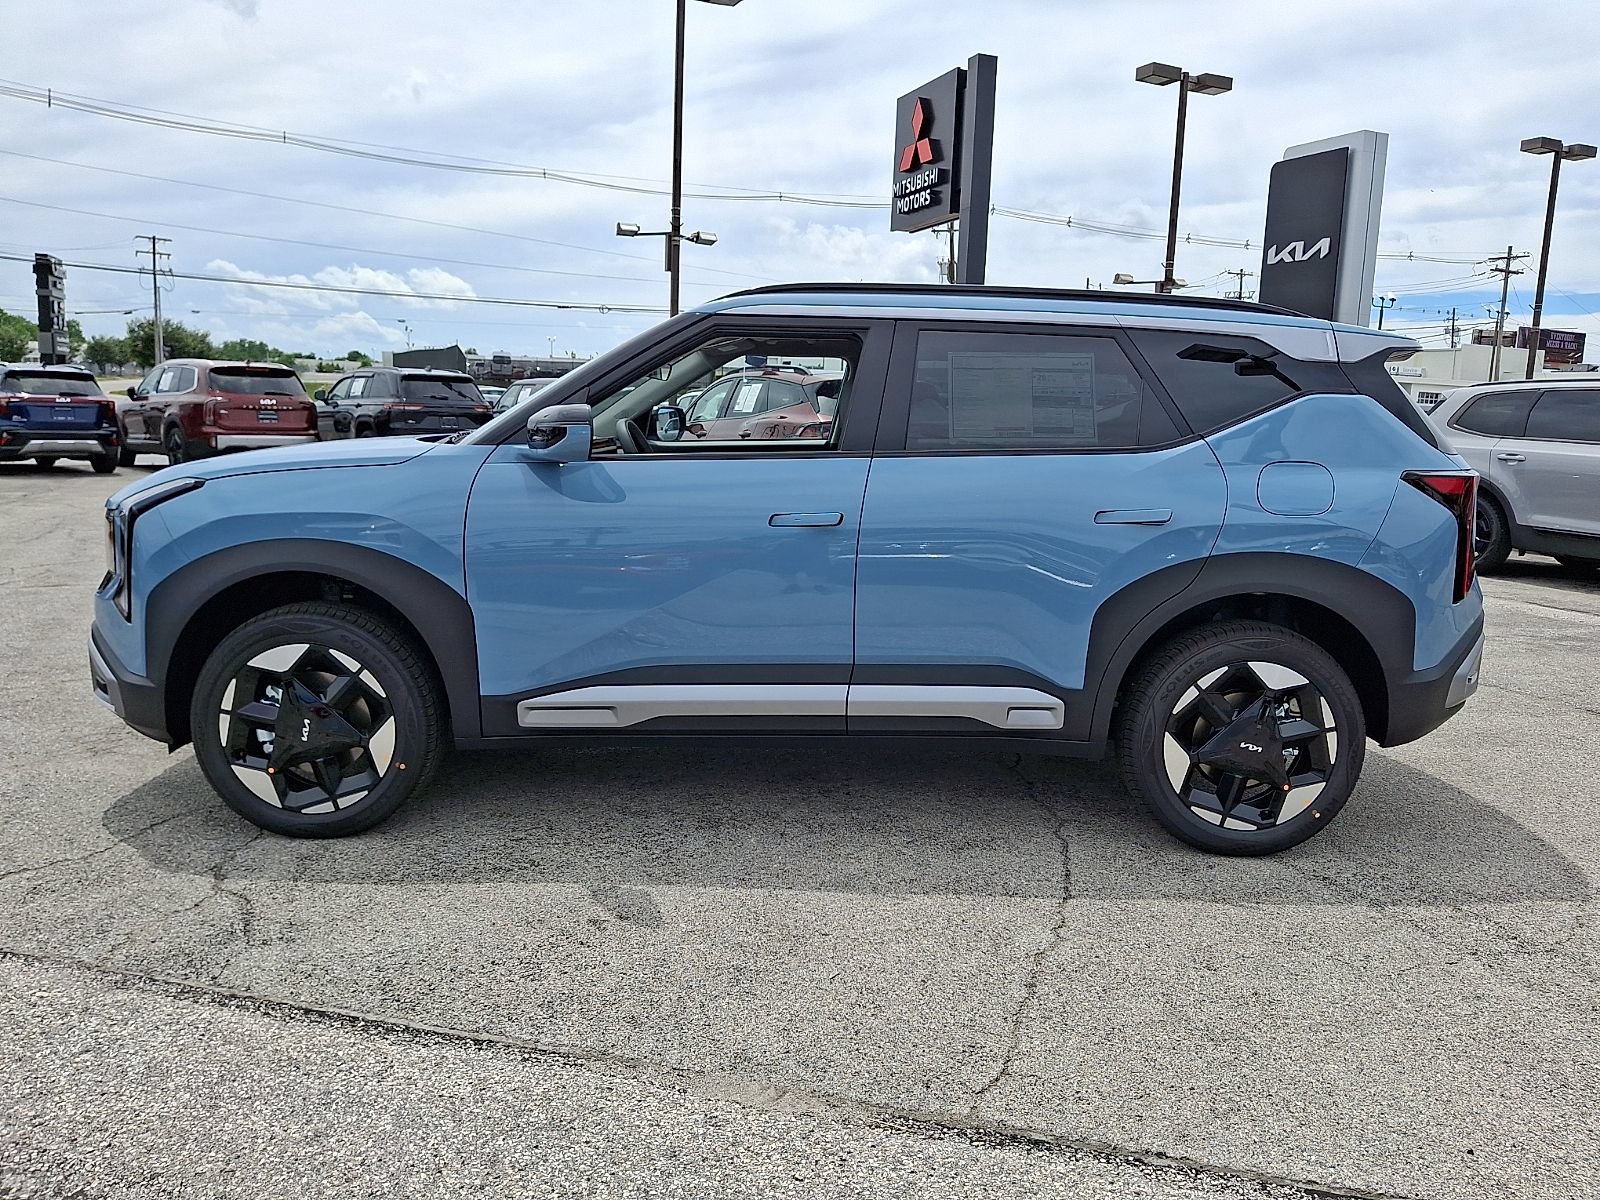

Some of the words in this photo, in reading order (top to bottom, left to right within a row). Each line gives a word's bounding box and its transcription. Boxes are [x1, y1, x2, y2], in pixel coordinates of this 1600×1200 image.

[893, 167, 939, 197] MITSUBISHI
[896, 189, 931, 214] MOTORS
[1266, 237, 1331, 265] KIA
[1160, 658, 1206, 702] SOLUS
